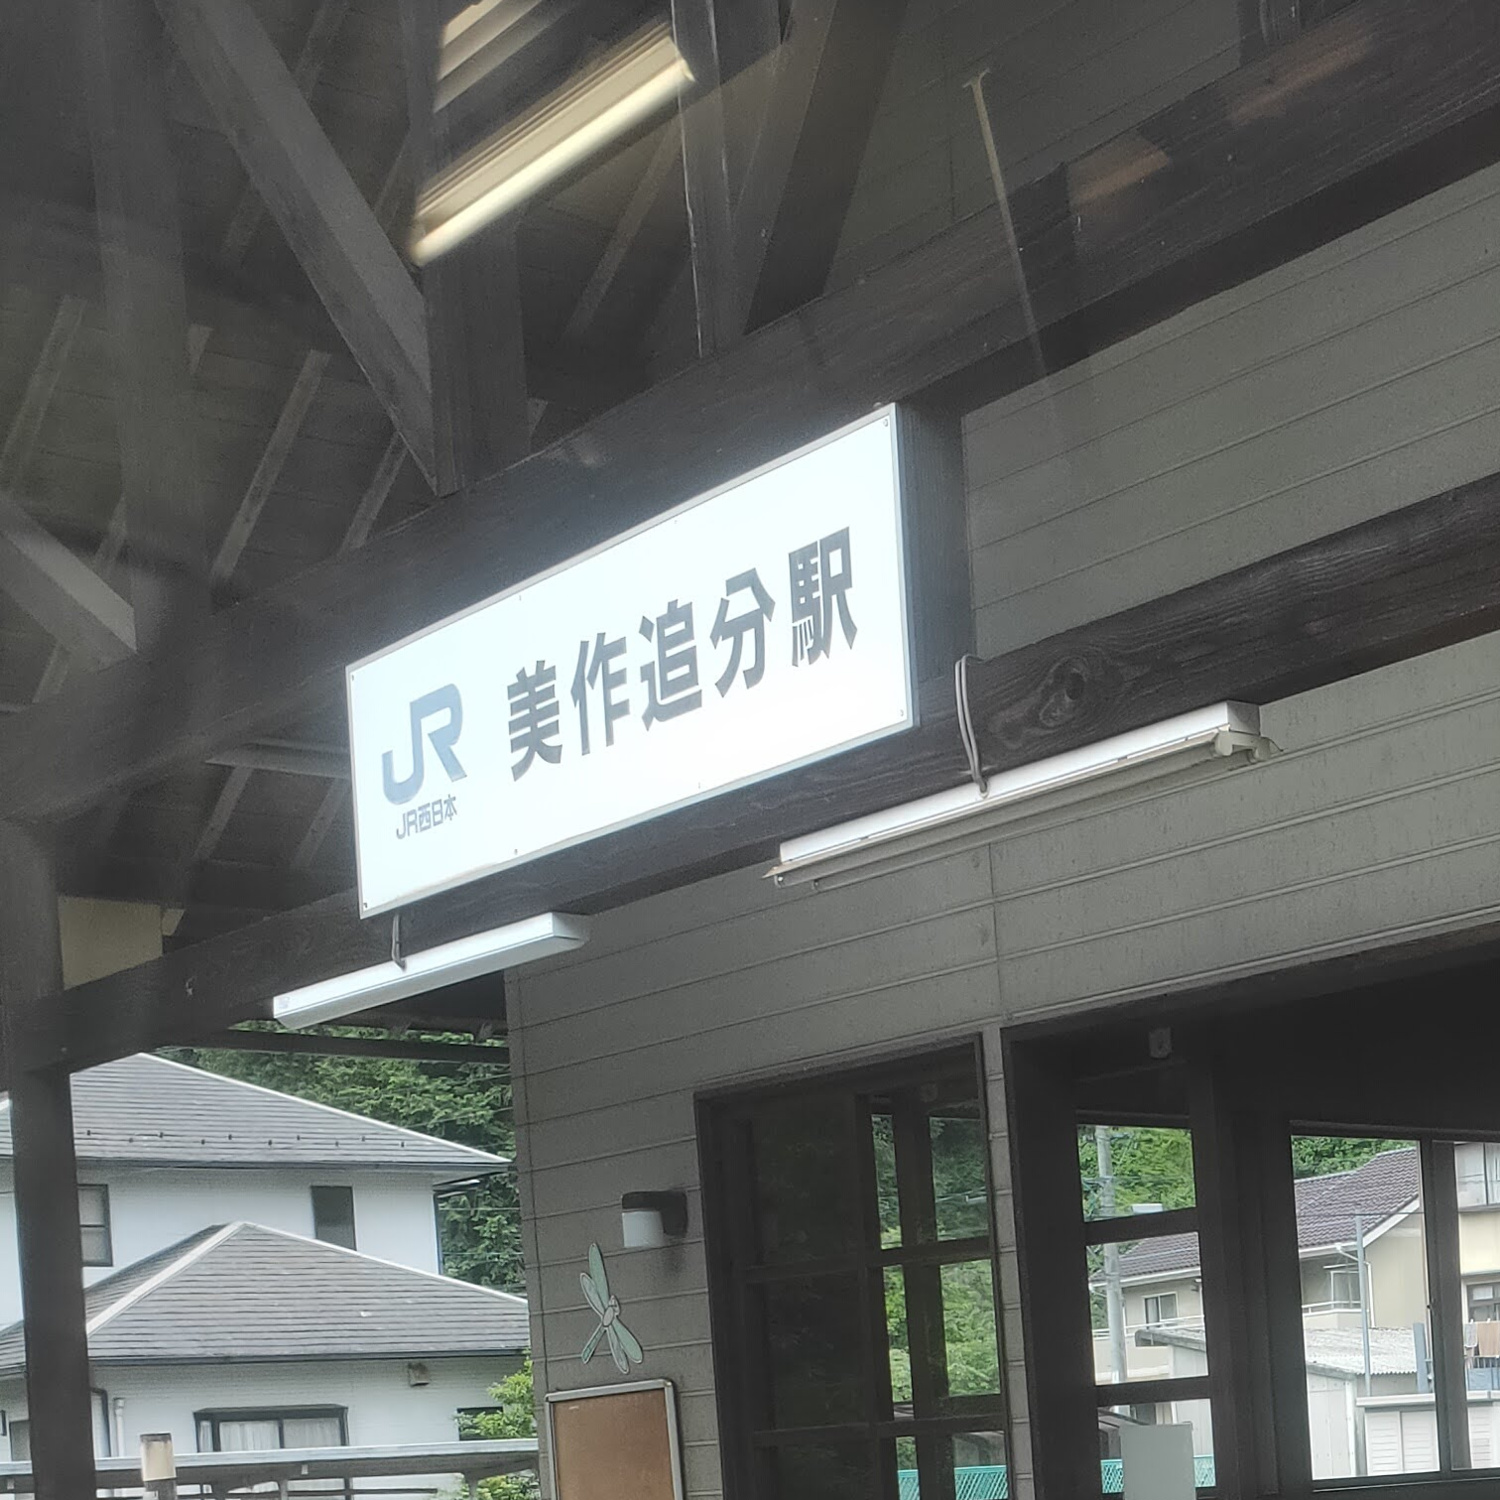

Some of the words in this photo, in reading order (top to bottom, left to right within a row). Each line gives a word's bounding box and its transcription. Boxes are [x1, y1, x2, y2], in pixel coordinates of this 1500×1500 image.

[507, 526, 857, 781] 美作追分駅
[382, 683, 467, 805] JR
[396, 794, 457, 839] JR西日本
